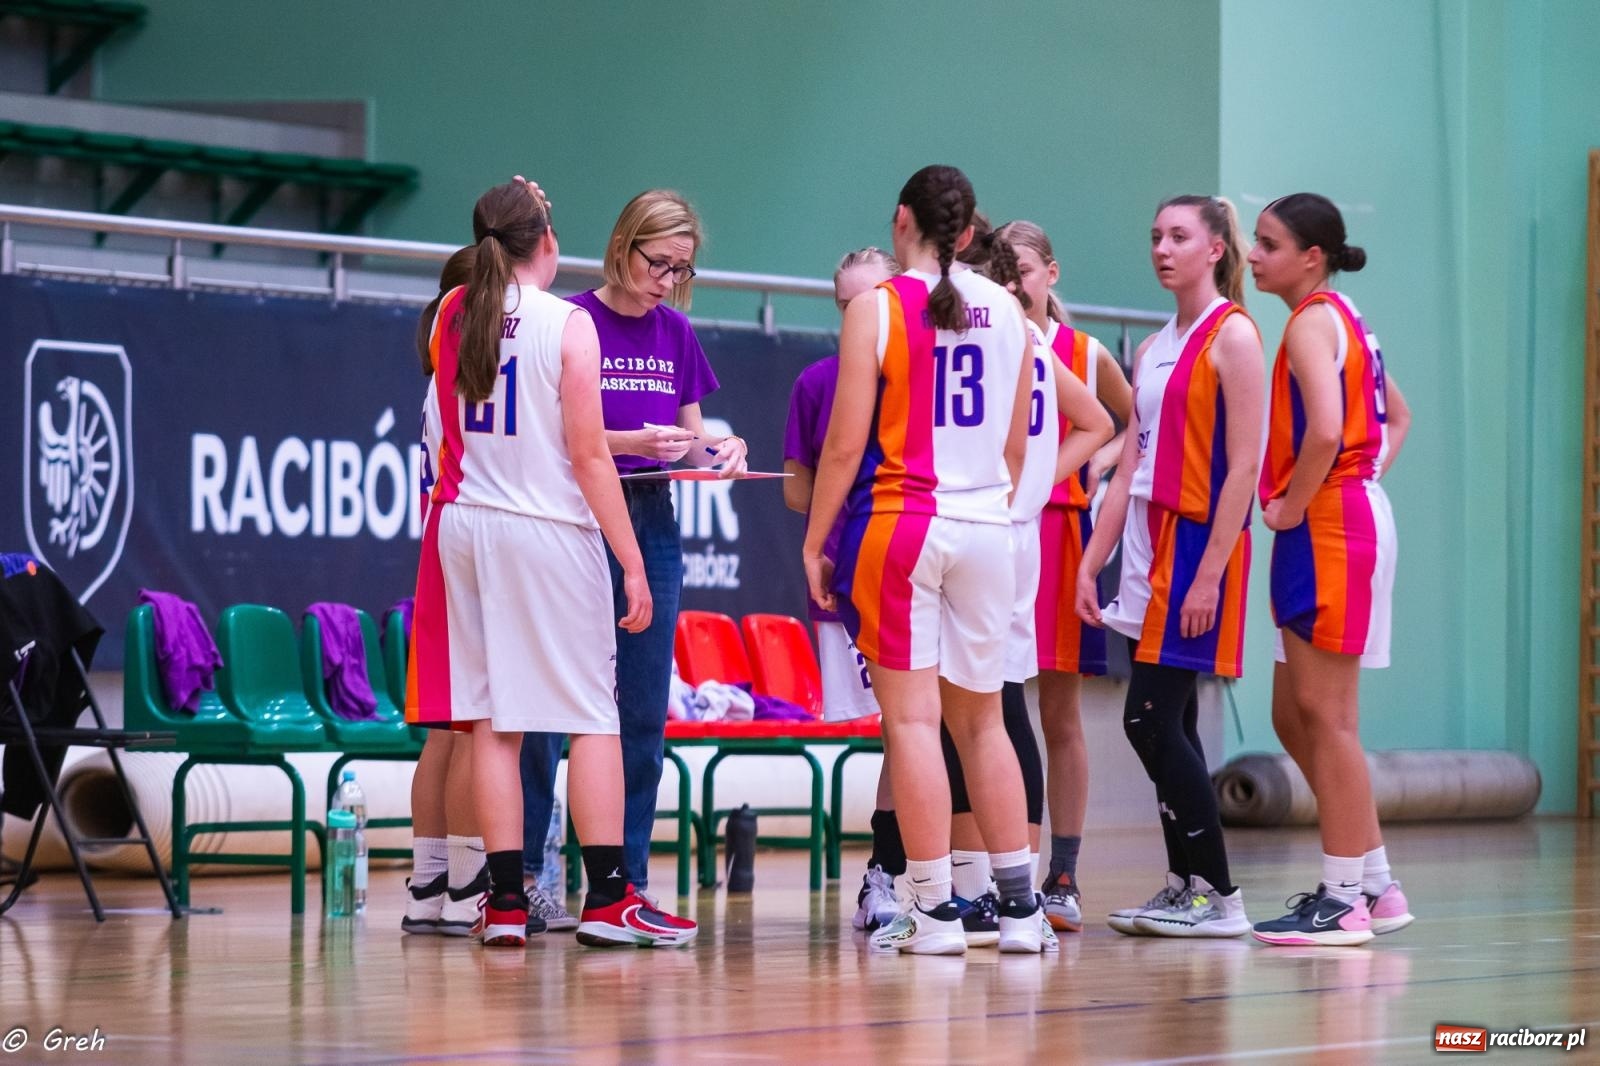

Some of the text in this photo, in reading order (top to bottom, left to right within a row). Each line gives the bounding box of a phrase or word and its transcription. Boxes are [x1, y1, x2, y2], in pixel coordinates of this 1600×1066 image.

[601, 377, 675, 395] ASKETBALL
[602, 355, 674, 374] ACIBÓRZ
[933, 344, 984, 427] 13
[191, 406, 421, 540] RACIBÓ
